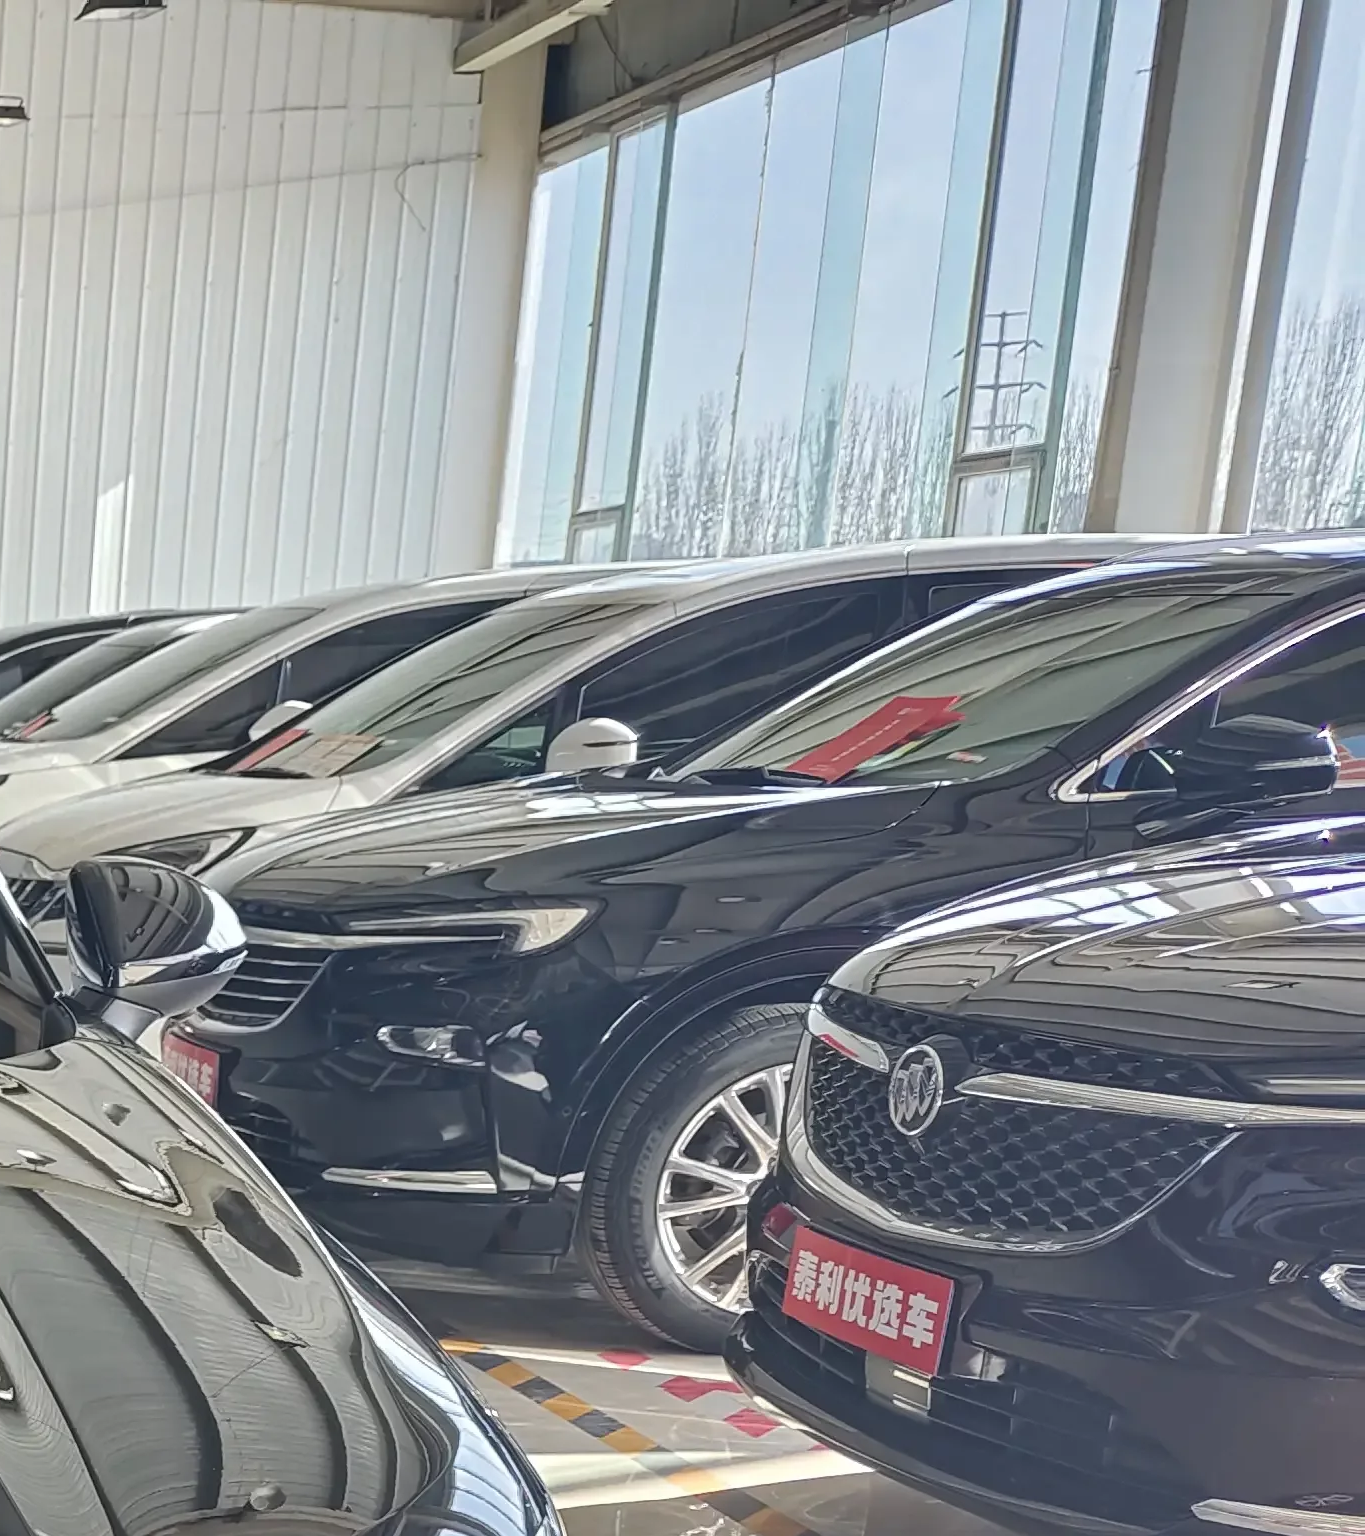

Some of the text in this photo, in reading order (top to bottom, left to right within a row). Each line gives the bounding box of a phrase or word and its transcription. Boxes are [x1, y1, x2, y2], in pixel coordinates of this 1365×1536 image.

[791, 1249, 939, 1349] 泰利优选车
